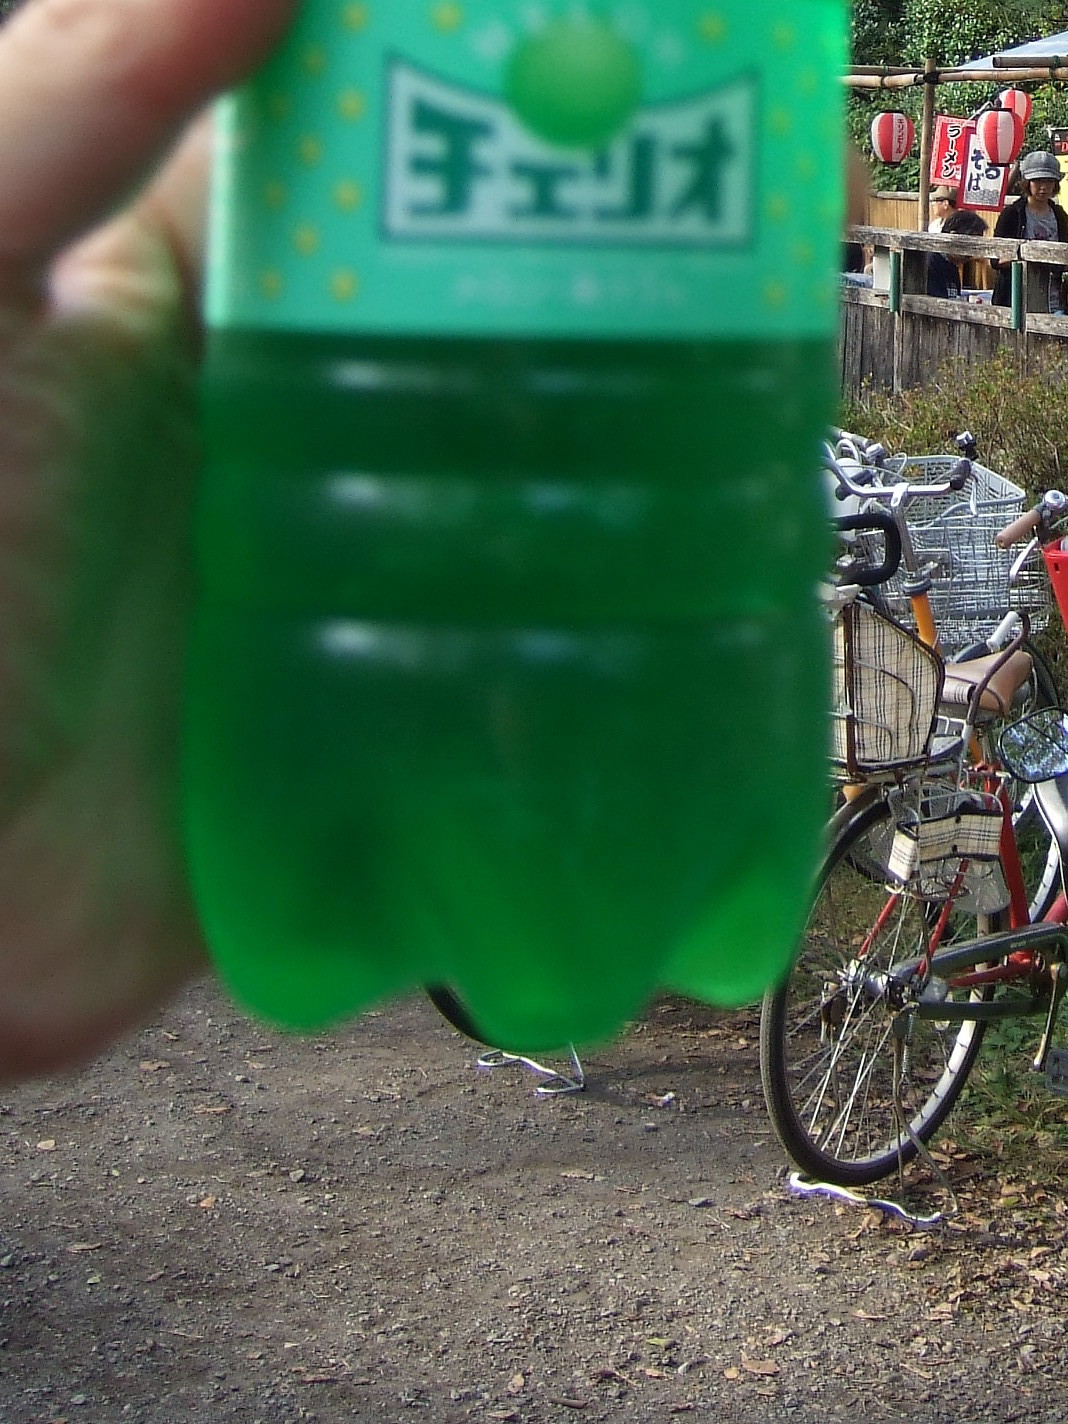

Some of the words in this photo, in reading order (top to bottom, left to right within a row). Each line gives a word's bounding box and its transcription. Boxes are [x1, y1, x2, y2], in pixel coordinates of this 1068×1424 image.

[407, 97, 737, 225] チェリオ
[942, 125, 961, 178] ラーメン
[967, 148, 985, 192] そば
